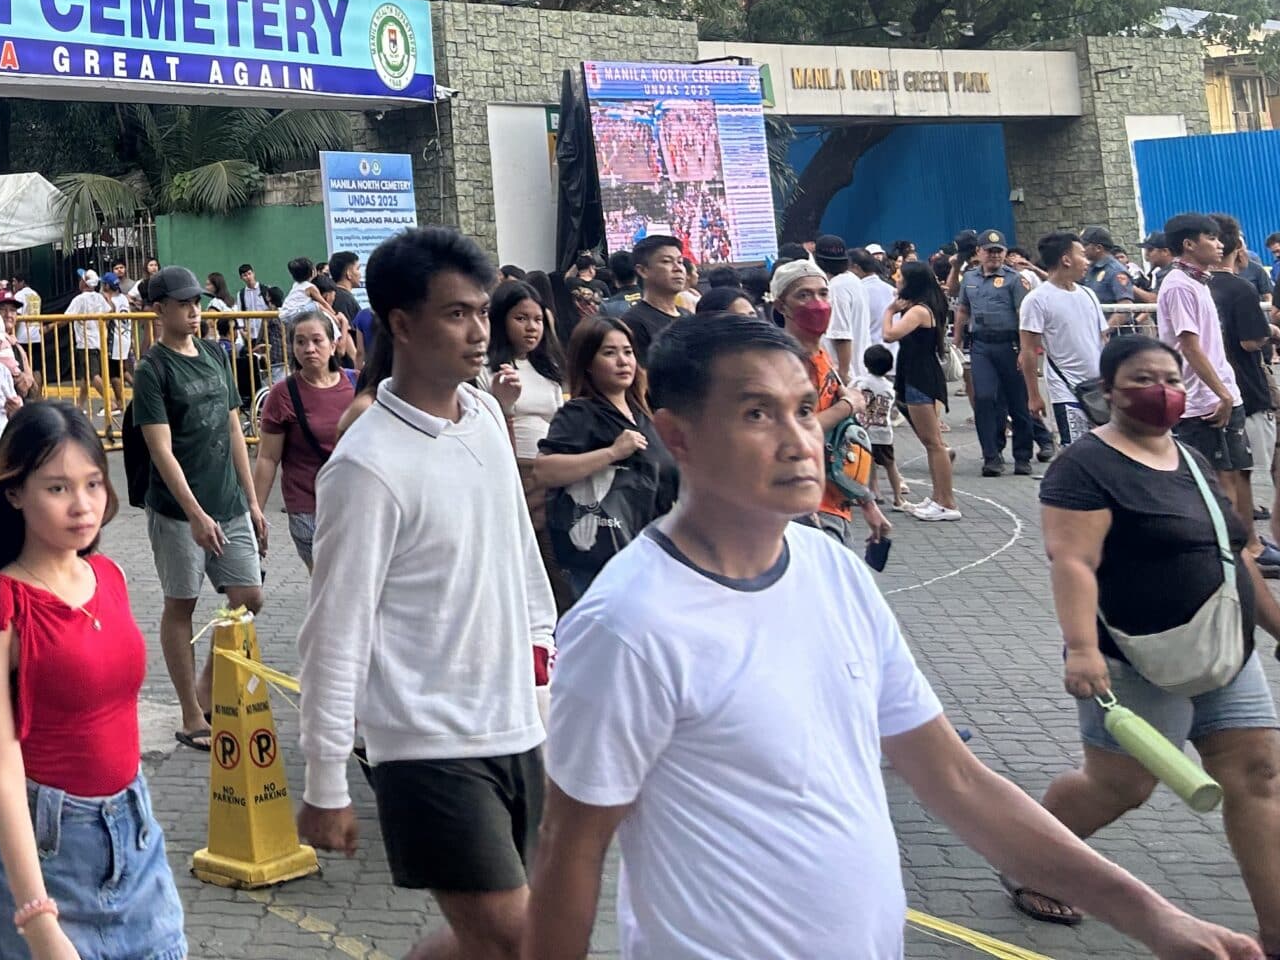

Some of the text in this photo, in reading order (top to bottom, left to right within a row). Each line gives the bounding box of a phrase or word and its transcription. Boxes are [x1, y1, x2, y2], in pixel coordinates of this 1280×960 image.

[53, 46, 180, 81] GREAT
[209, 60, 314, 90] AGAIN
[604, 67, 743, 84] MANILA NORTH CEMETERY
[791, 67, 991, 93] MANILA NORTH GREEN PARK
[644, 84, 711, 96] UNDAS 2025
[330, 178, 411, 191] MANILA NORTH CEMETERY
[348, 194, 399, 207] UNDAS 2025
[334, 216, 415, 224] MAHALAGANG PAALALA
[222, 736, 235, 765] P
[256, 734, 271, 763] P
[223, 785, 235, 795] NO
[263, 782, 276, 791] NO
[213, 791, 246, 806] PARKING
[254, 787, 287, 803] PARKING
